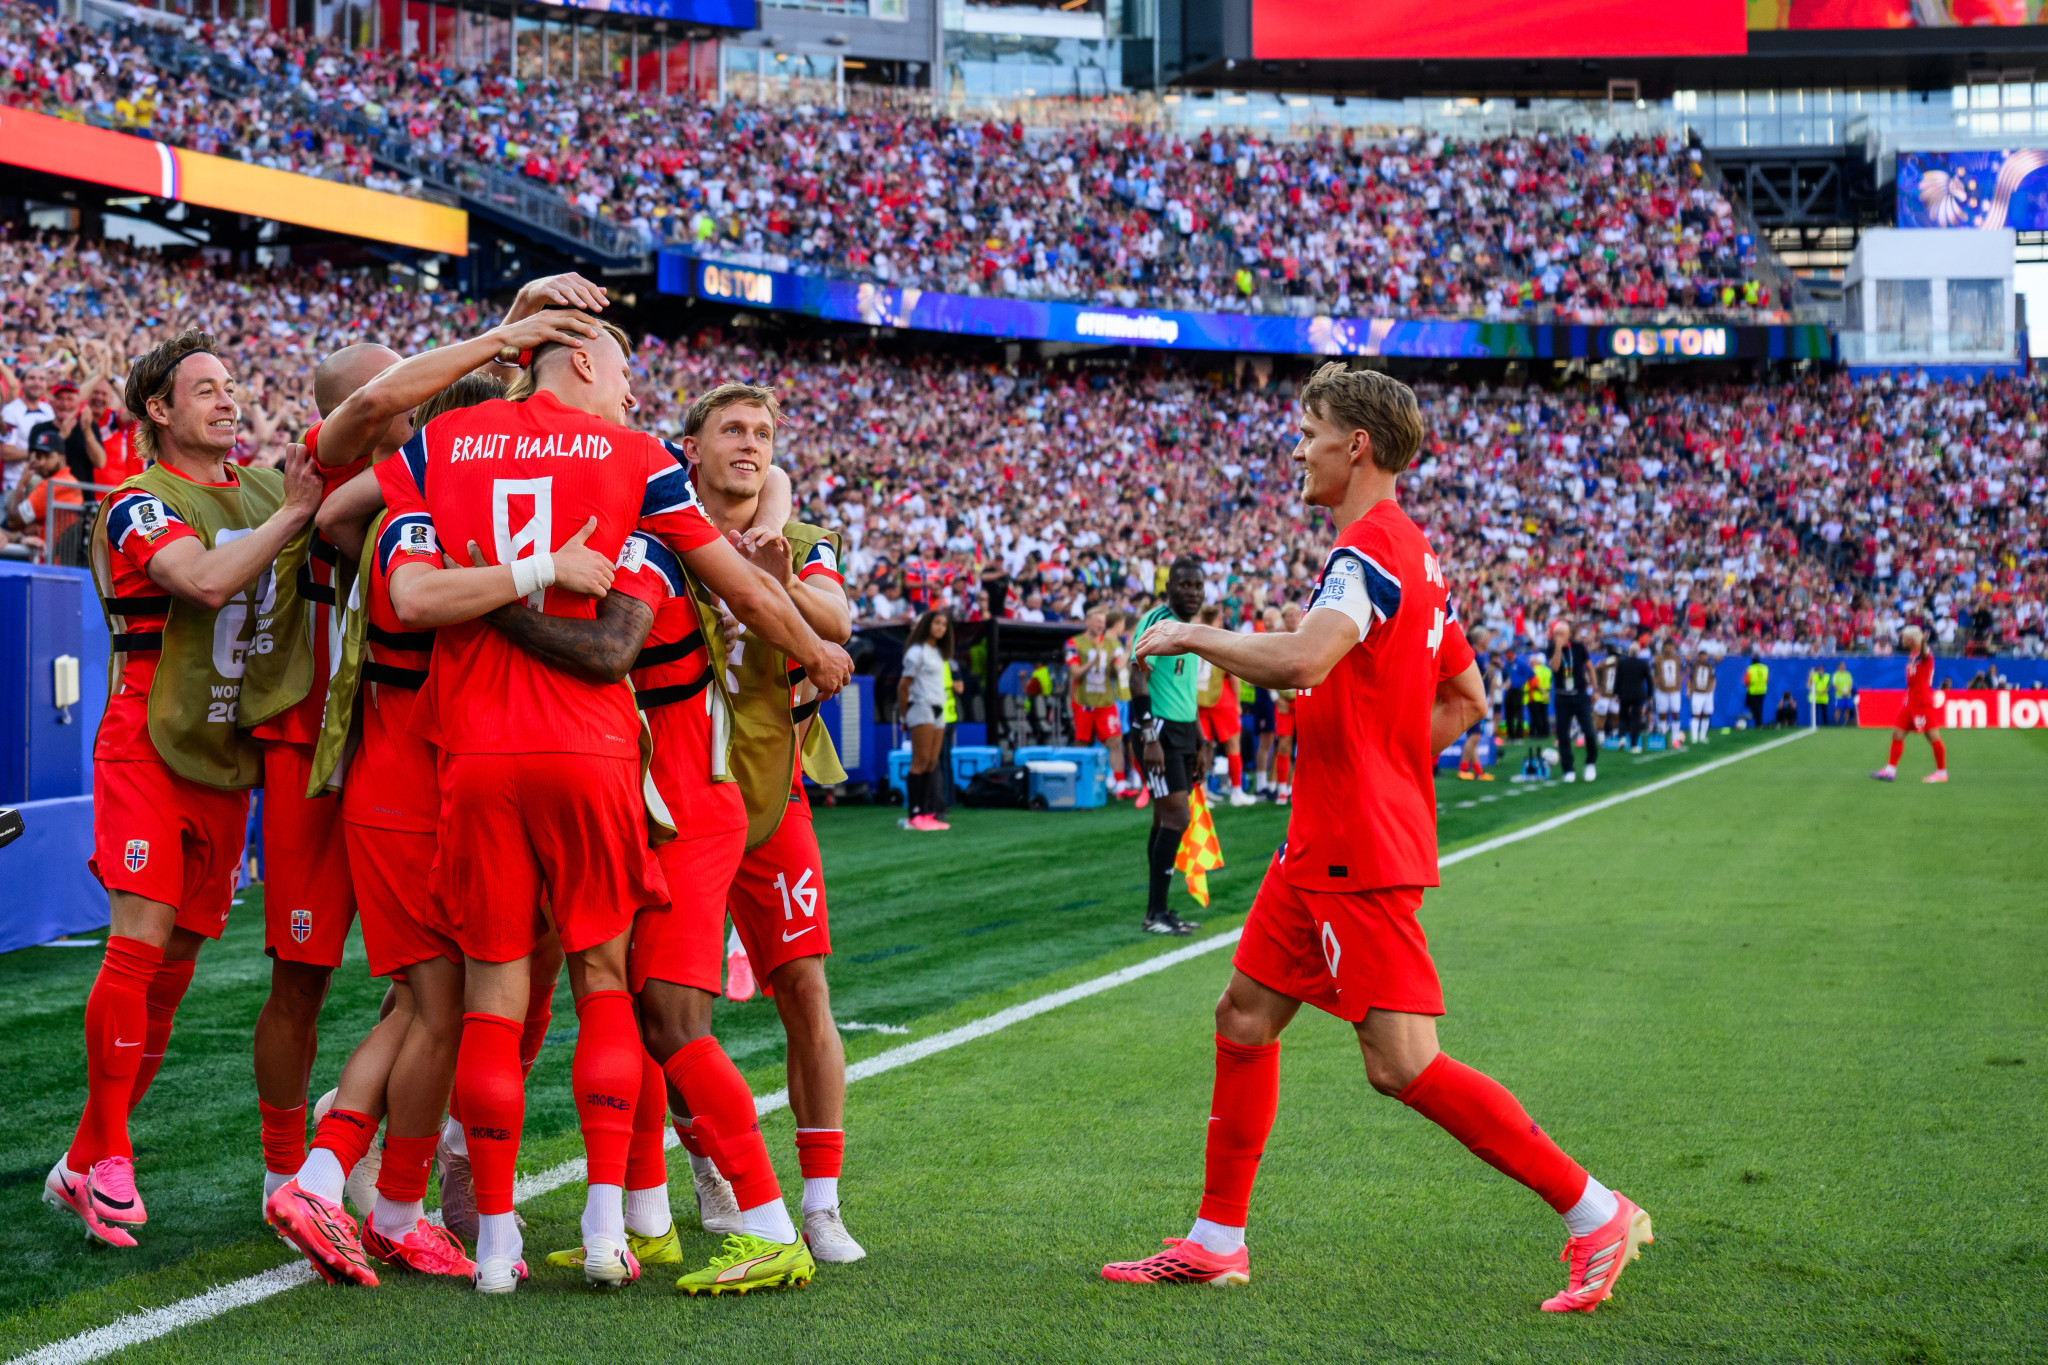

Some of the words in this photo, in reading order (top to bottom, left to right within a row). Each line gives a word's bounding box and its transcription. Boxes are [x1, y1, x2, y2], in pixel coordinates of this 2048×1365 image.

[1612, 328, 1726, 355] OSTON
[451, 434, 510, 463] BRAUT
[514, 434, 612, 460] HAALAND
[211, 686, 240, 699] WOR
[207, 702, 239, 723] 20
[773, 868, 818, 921] 16
